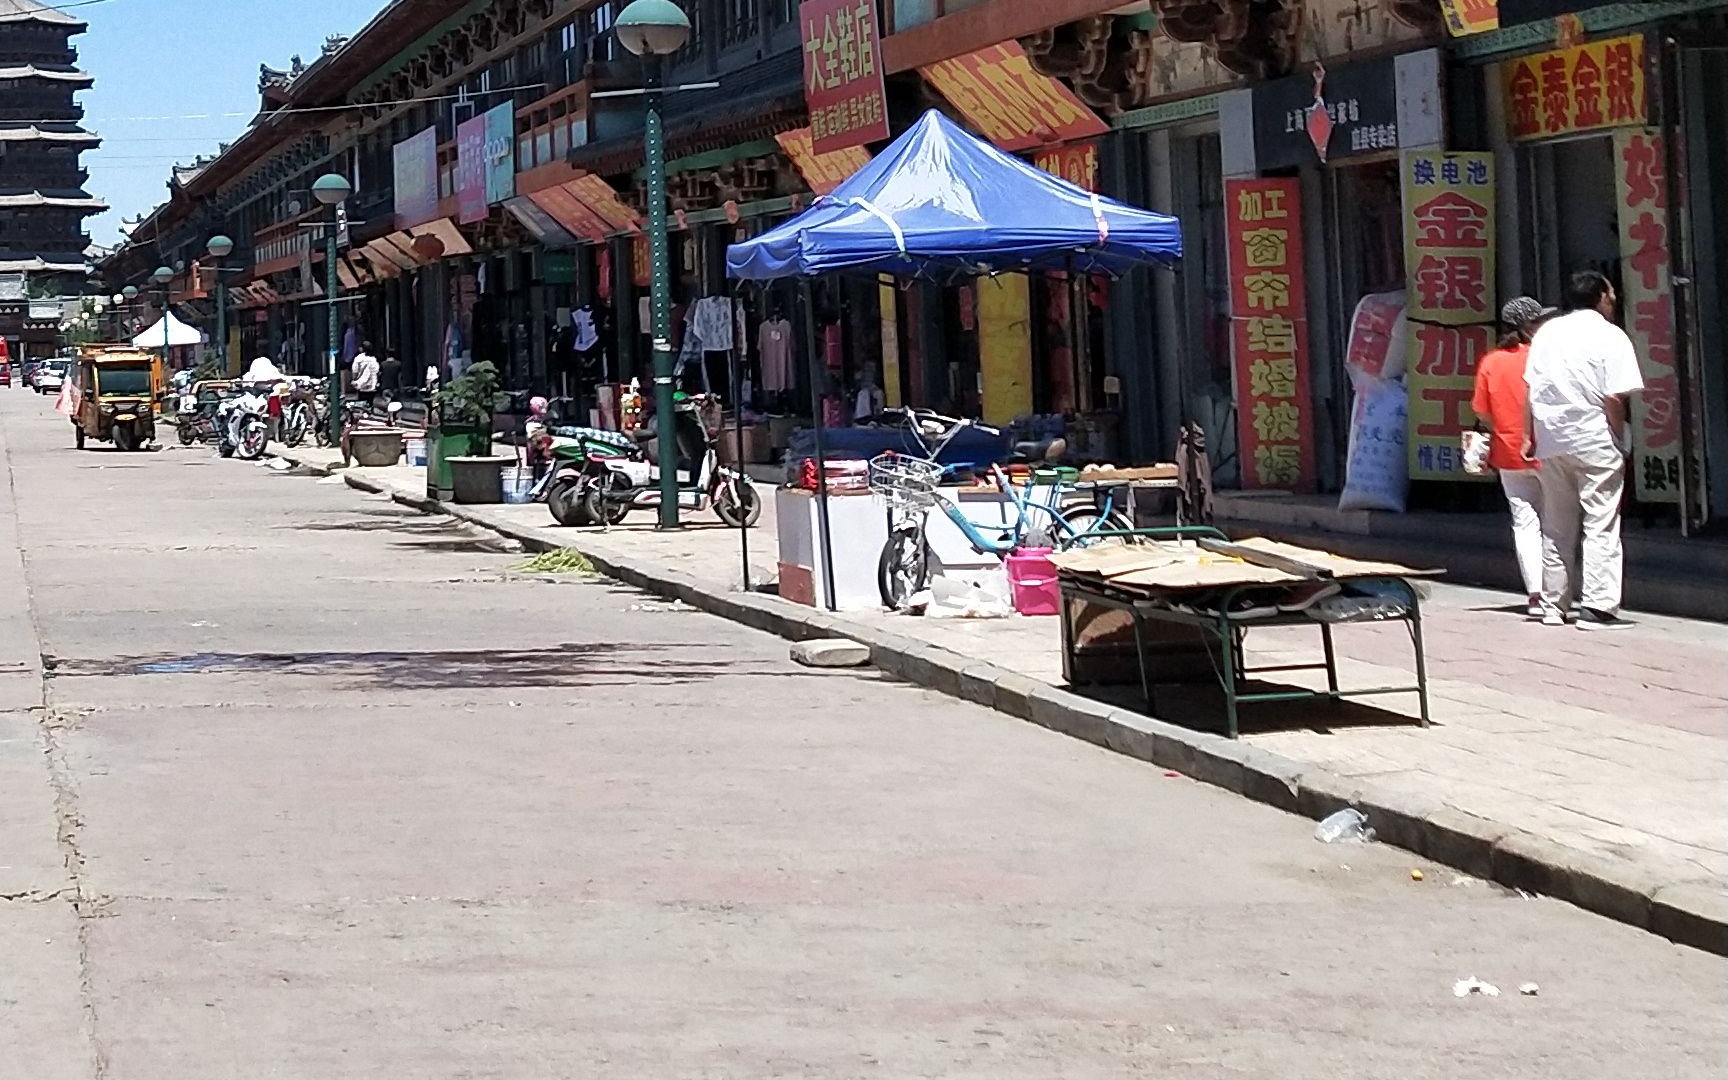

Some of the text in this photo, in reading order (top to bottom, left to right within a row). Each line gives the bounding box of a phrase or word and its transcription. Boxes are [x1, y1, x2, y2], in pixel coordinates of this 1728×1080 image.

[1509, 40, 1647, 136] 金泰金银
[1413, 159, 1488, 186] 换电池
[1238, 190, 1287, 221] 加工
[1413, 191, 1489, 437] 金银加工
